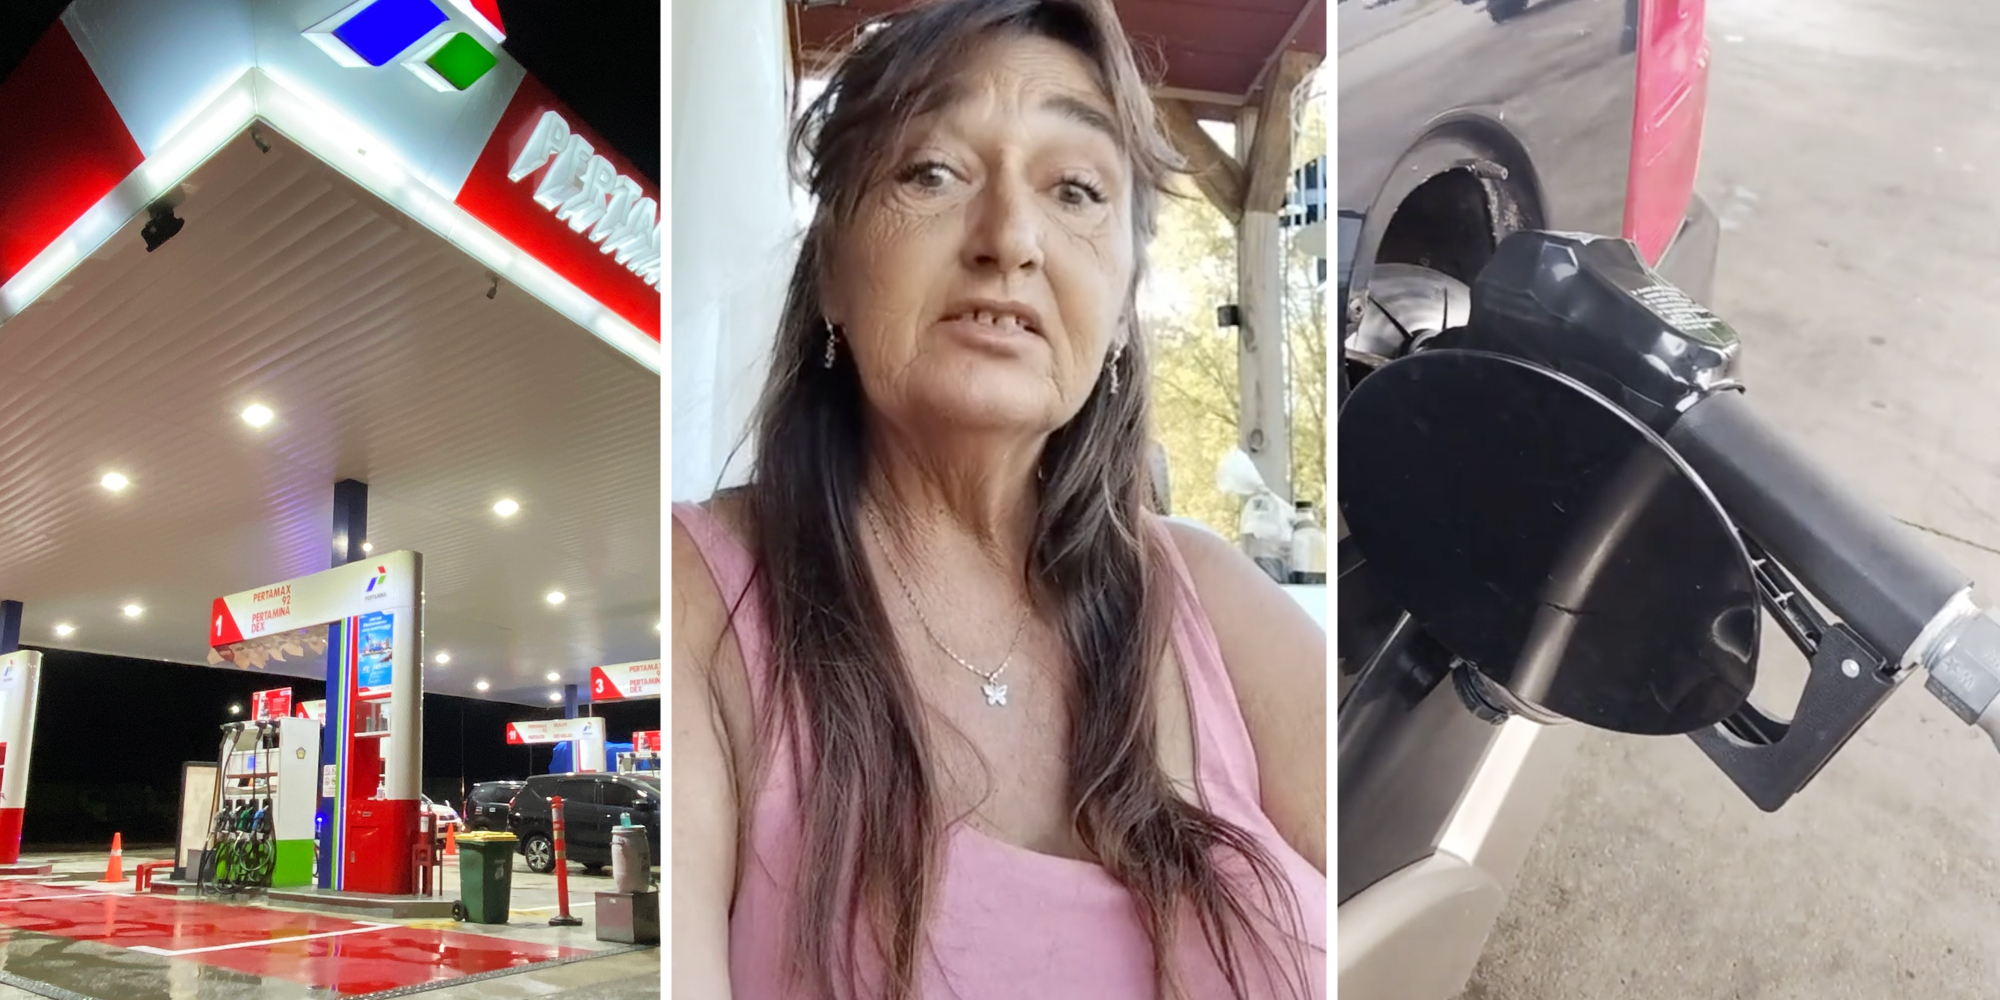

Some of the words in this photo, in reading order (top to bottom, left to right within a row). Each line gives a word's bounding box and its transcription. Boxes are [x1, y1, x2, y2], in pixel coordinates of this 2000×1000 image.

[253, 584, 292, 602] PERTAMAX
[281, 595, 291, 606] 92
[251, 606, 291, 623] PERTAMINA
[215, 614, 223, 637] 1
[251, 622, 265, 633] DEX
[628, 663, 661, 673] PERTAMA
[595, 678, 604, 694] 3
